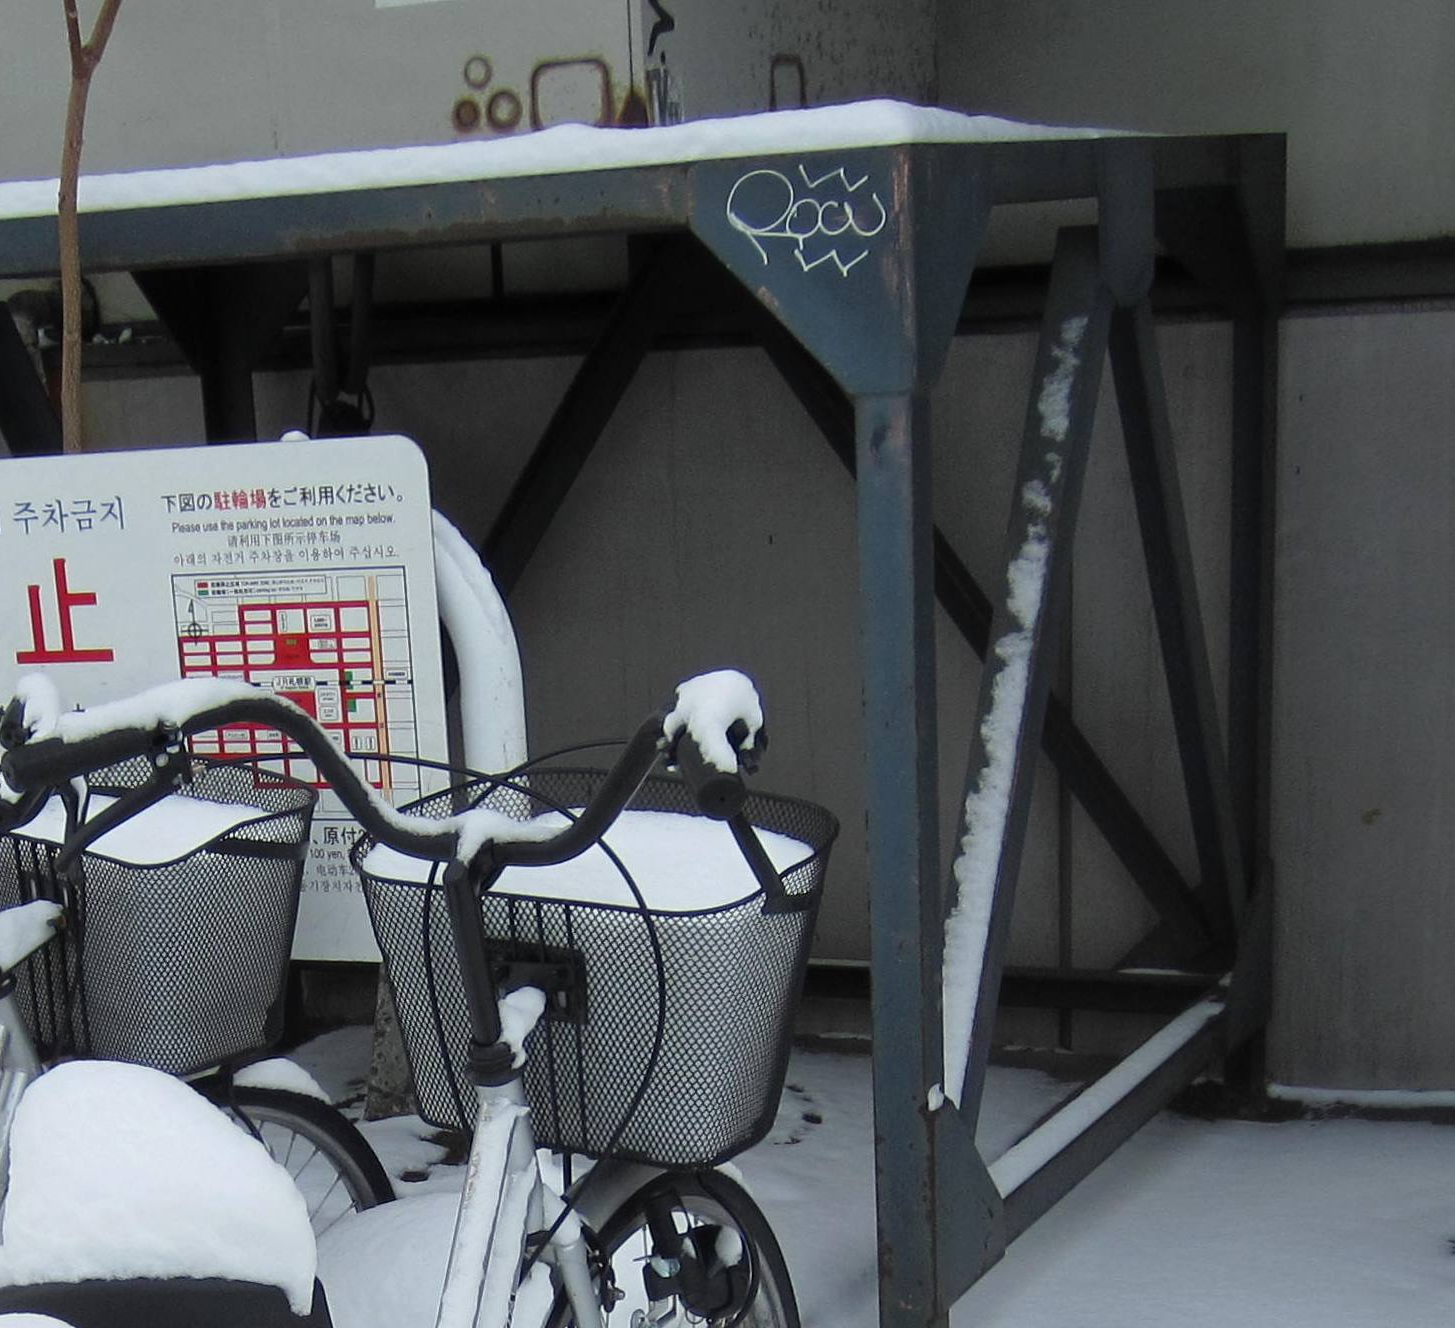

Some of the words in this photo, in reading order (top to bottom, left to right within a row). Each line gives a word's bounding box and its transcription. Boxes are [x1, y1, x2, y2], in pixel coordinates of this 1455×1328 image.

[161, 484, 403, 513] 下図の駐輪場をご利用ください。
[12, 496, 126, 534] 주차금지
[172, 522, 201, 533] Please
[202, 522, 218, 532] use
[220, 520, 234, 531] the
[236, 519, 267, 532] parking
[269, 517, 280, 529] lot
[282, 516, 313, 528] located
[316, 517, 327, 527] on
[329, 515, 343, 526] the
[346, 516, 364, 527] map
[367, 512, 396, 524] below.
